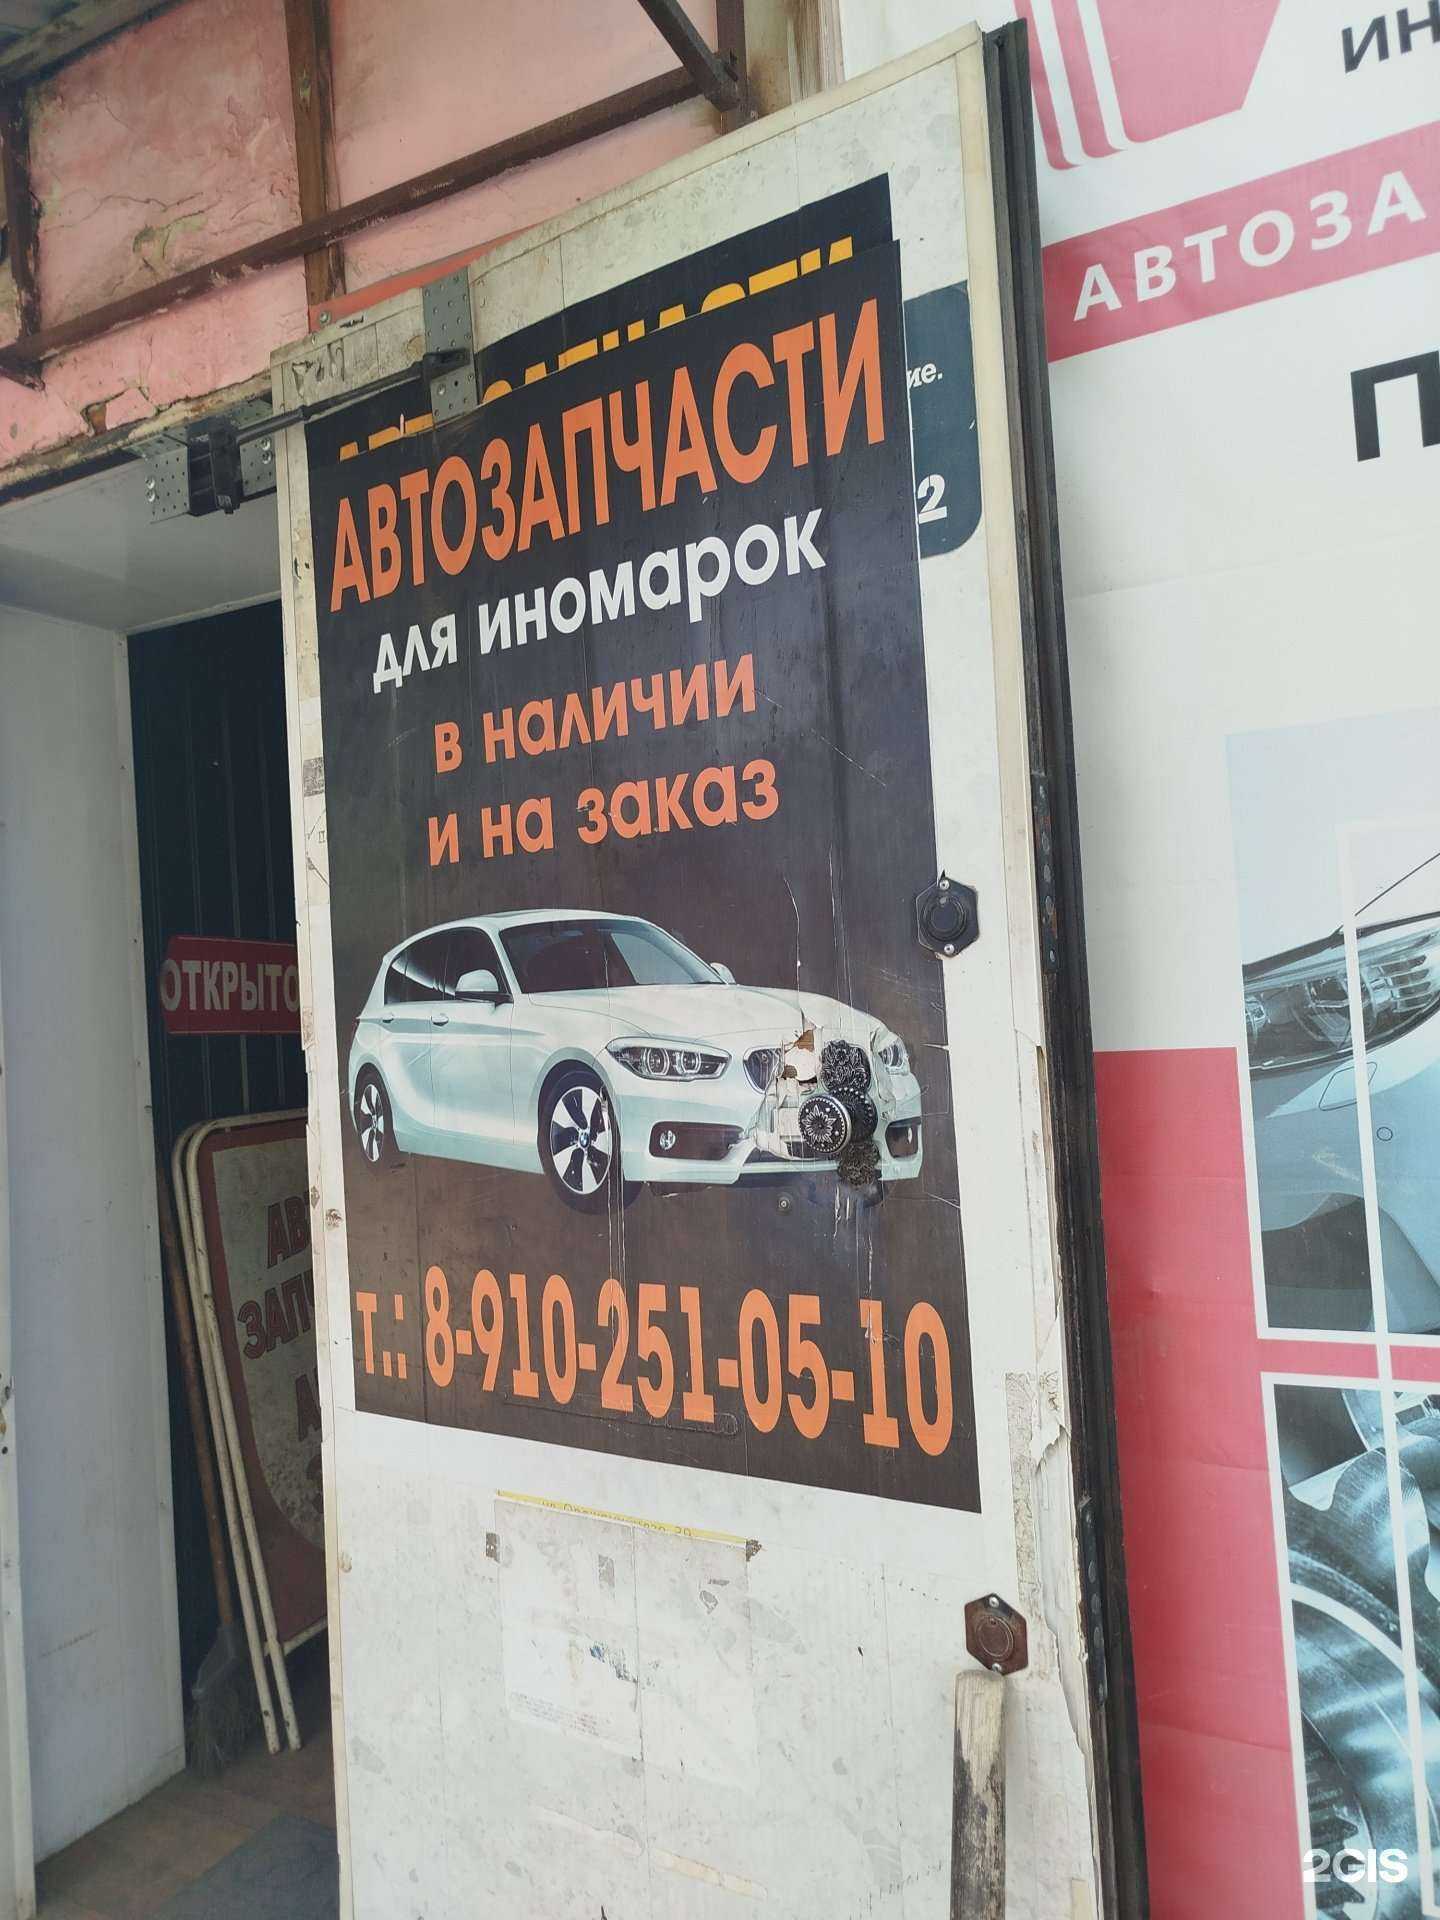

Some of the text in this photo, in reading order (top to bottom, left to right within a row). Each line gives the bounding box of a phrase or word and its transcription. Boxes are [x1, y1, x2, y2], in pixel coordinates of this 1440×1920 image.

[1073, 170, 1427, 322] АВТОЗА
[330, 298, 885, 612] АВТОЗАПЧАСТИ
[917, 474, 948, 524] 2
[373, 508, 826, 693] для иномарок
[434, 653, 756, 774] в наличии
[428, 759, 779, 866] и на заказ
[160, 959, 300, 1012] ОТКРЫТО
[425, 1265, 953, 1456] 8-910-251-05-10
